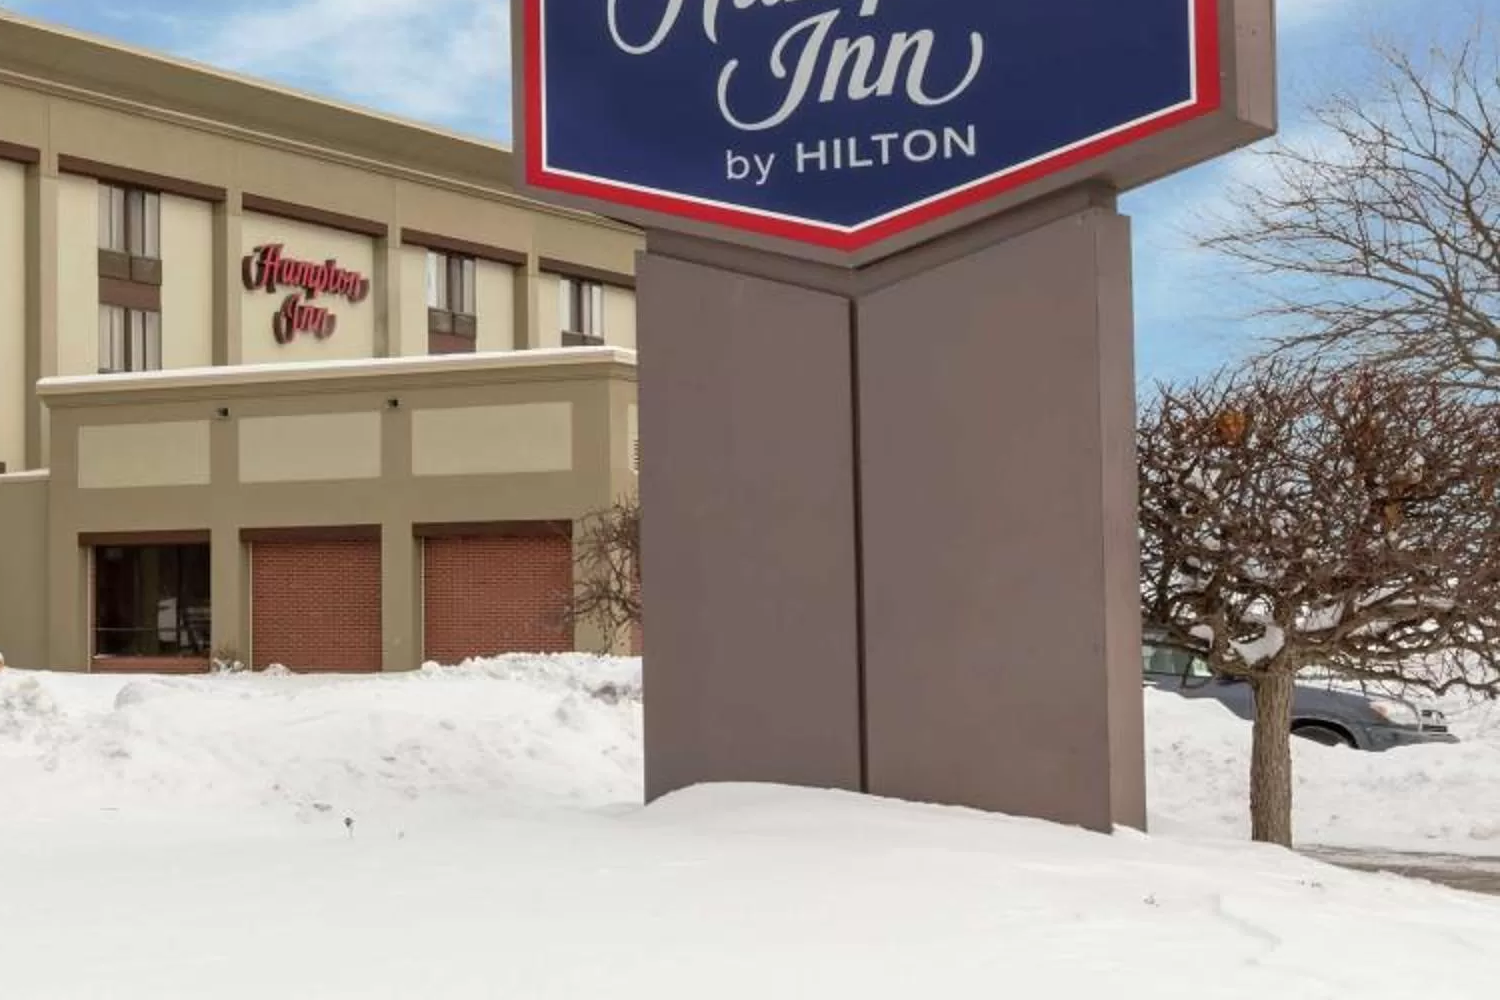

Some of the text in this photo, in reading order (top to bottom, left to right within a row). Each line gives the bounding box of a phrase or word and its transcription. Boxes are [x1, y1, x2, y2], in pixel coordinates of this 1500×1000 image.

[717, 9, 984, 131] Inn
[726, 125, 976, 185] by HILTON
[242, 243, 370, 303] Hampton
[273, 293, 336, 345] Inn
